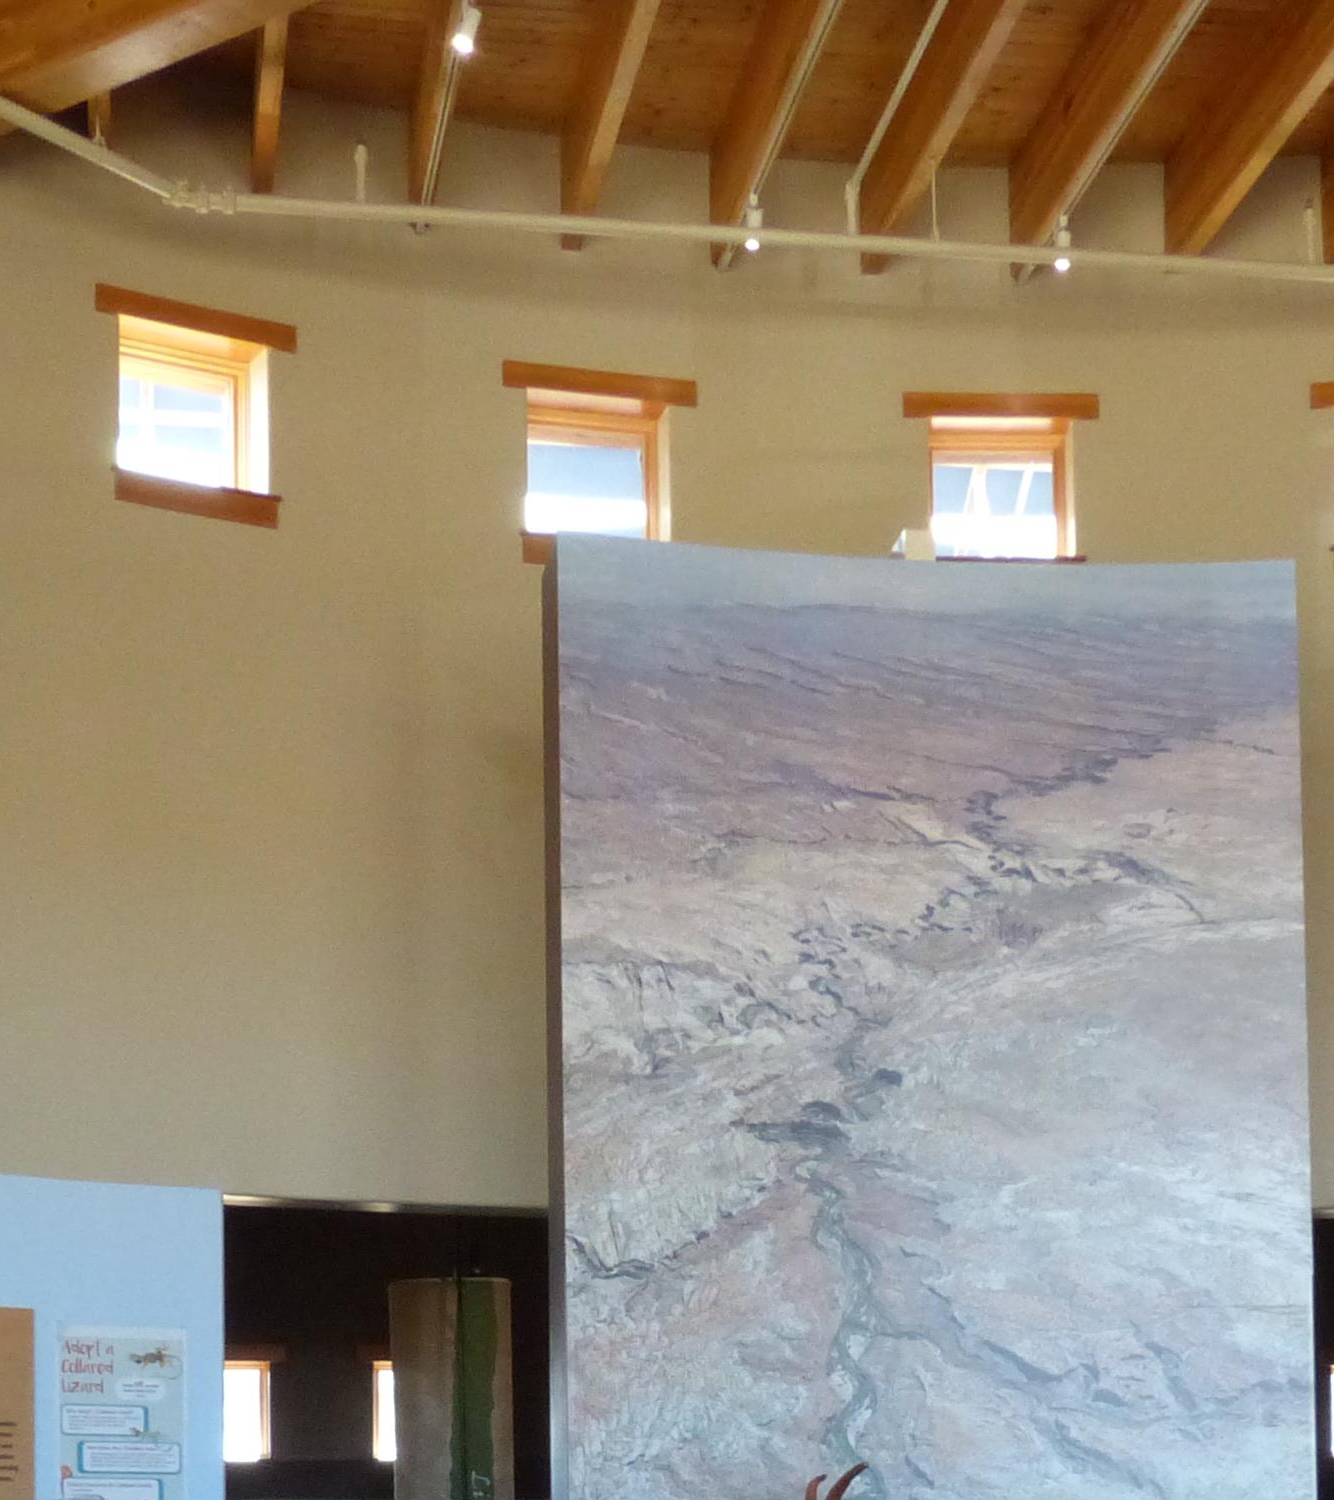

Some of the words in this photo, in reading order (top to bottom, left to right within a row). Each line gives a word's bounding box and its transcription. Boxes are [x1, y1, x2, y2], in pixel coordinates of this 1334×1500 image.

[63, 1339, 101, 1358] Adopt
[105, 1345, 115, 1356] a
[61, 1358, 114, 1376] Collared
[62, 1378, 105, 1394] Lizard
